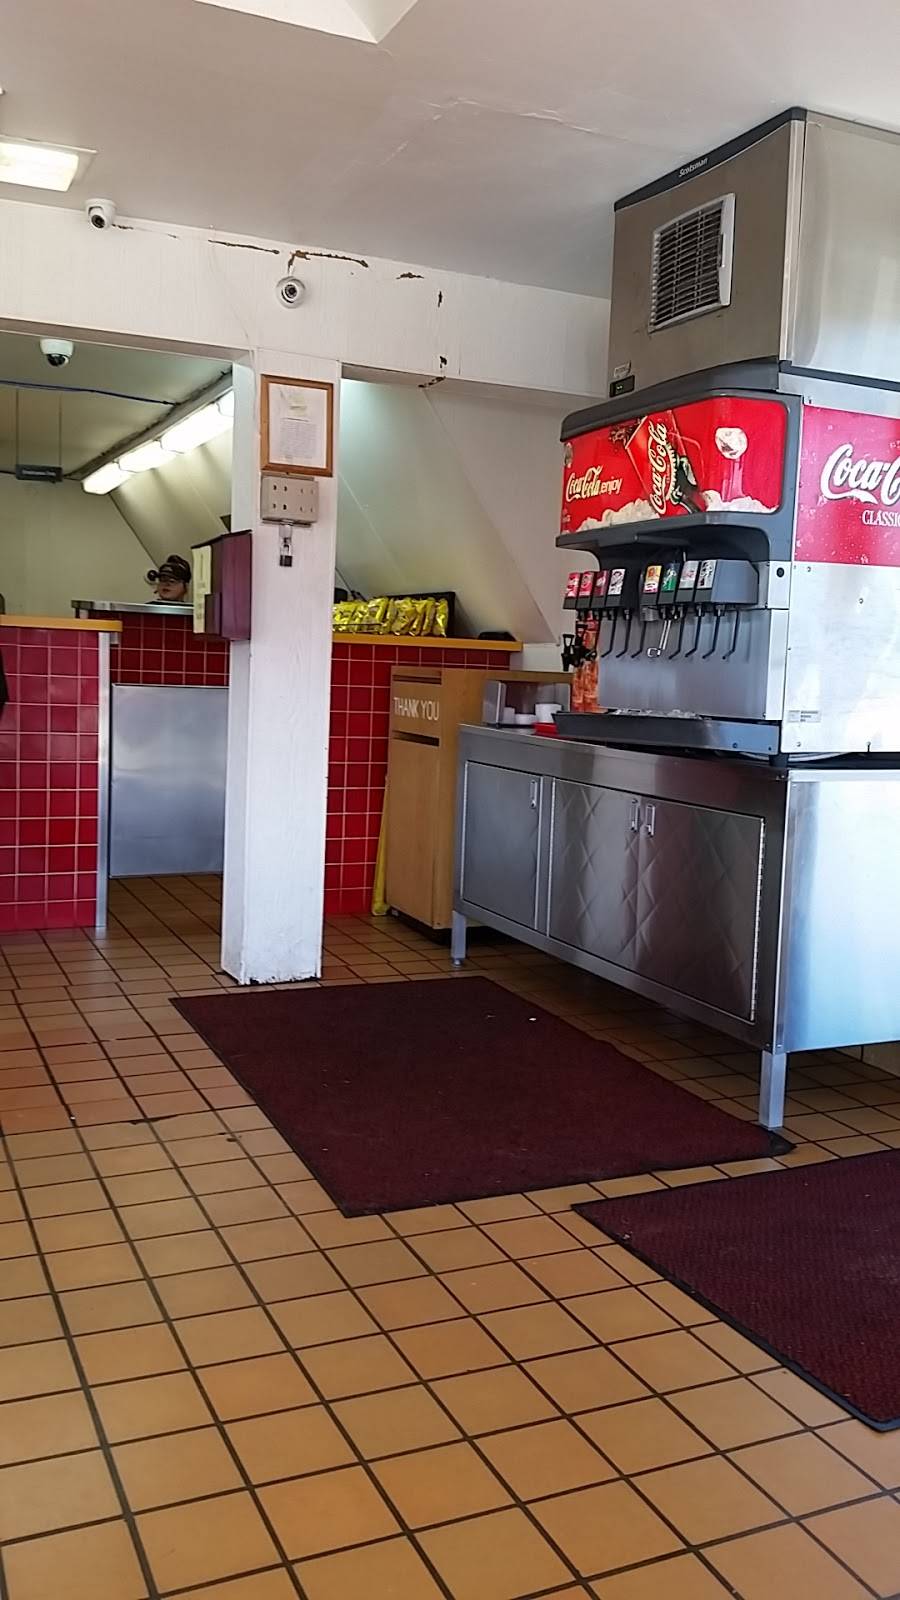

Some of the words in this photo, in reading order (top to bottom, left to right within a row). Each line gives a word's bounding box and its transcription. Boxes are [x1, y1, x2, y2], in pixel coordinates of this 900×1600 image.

[679, 157, 709, 178] Scotsman
[647, 419, 668, 515] Coca-Cola
[600, 476, 623, 495] enjoy
[393, 696, 420, 718] THANK
[420, 699, 440, 721] YOU
